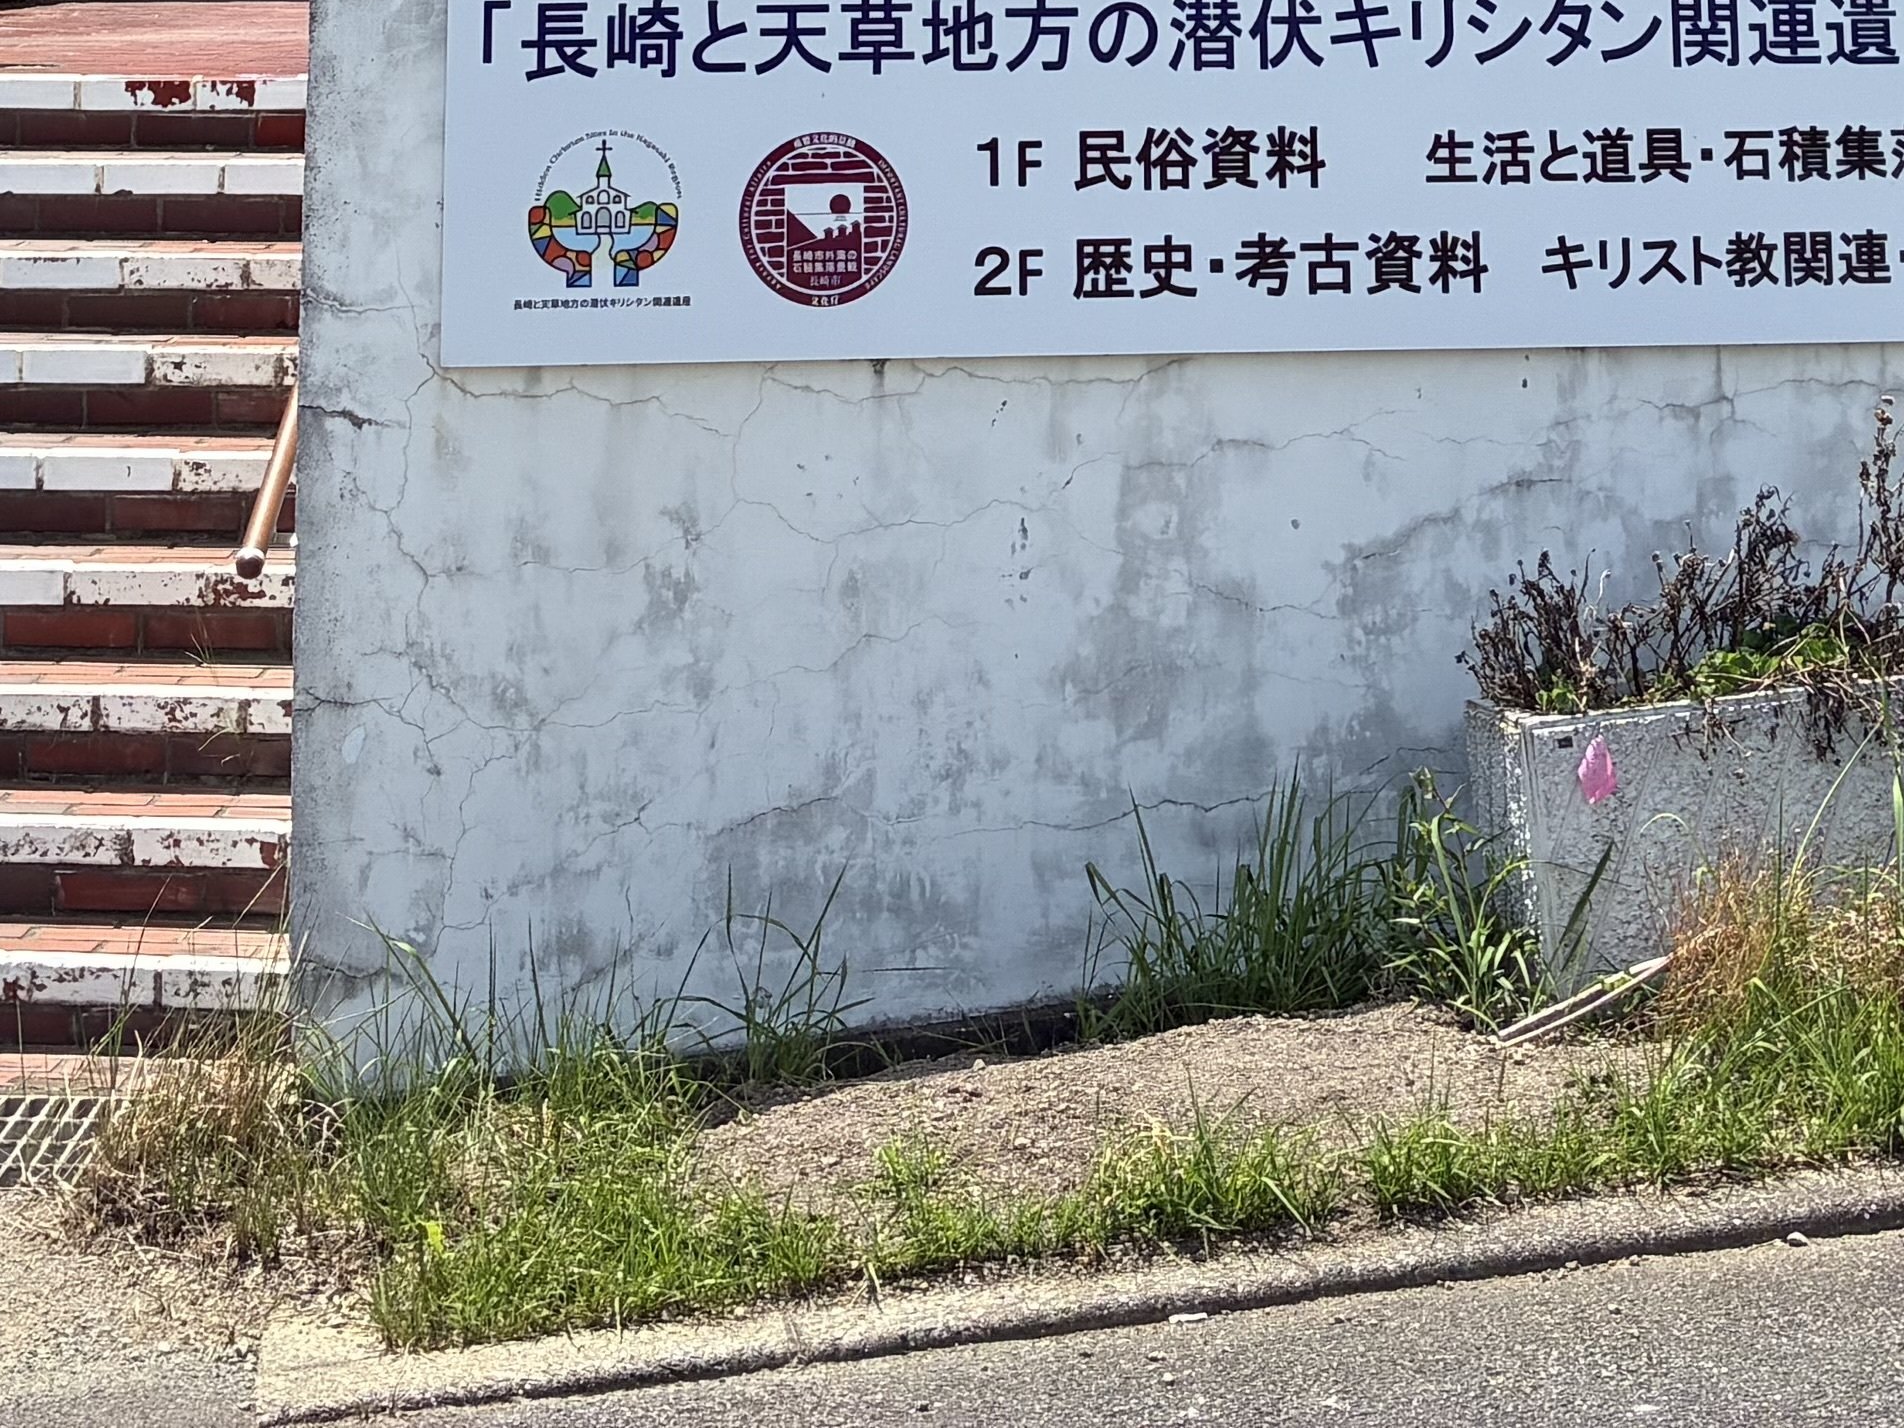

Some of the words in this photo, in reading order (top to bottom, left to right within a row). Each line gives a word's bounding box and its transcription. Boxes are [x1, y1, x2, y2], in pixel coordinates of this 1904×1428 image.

[976, 136, 1043, 188] 1F
[1074, 125, 1327, 192] 民俗資料
[973, 246, 1044, 297] 2F
[1072, 230, 1489, 300] 歴史・考古資料
